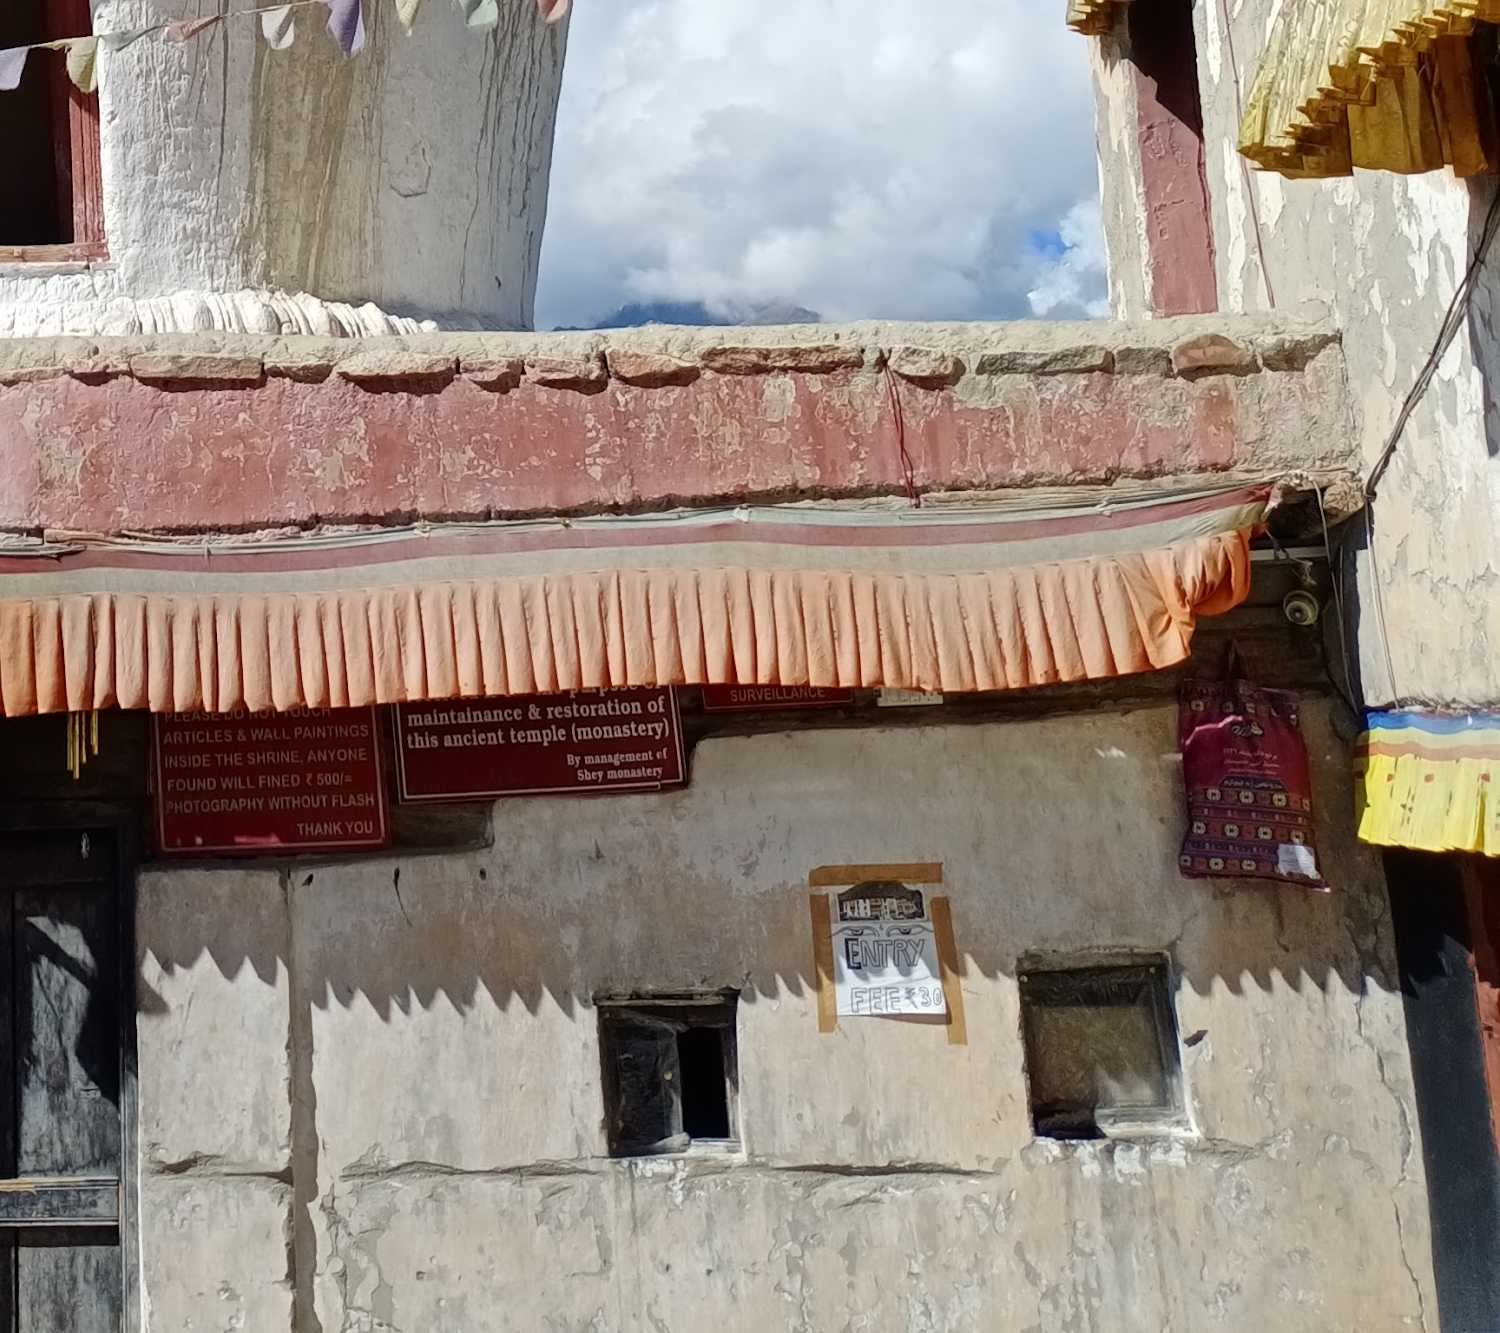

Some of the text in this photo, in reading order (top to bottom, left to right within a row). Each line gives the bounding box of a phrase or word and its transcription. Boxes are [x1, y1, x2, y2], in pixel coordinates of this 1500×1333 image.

[730, 686, 826, 703] SURVEILLANCE
[164, 710, 220, 723] PLEASE
[407, 704, 522, 727] maintainance
[528, 703, 541, 720] &
[546, 697, 643, 720] restoration
[647, 695, 666, 713] of
[163, 724, 369, 745] ARTICLES & WALL PAINTINGS
[407, 717, 670, 749] this ancient temple (monastery)
[164, 747, 368, 768] INSIDE THE SHRINE, ANYONE
[567, 748, 668, 768] By management of
[167, 778, 217, 792] FOUND
[219, 775, 255, 789] WILL
[259, 773, 300, 788] FINED
[577, 765, 664, 783] Shey monastery
[166, 792, 375, 814] PHOTOGRAPHY WITHOUT FLASH
[297, 820, 373, 837] THANK YOU
[844, 938, 925, 969] ENTRY
[851, 987, 902, 1014] FEE
